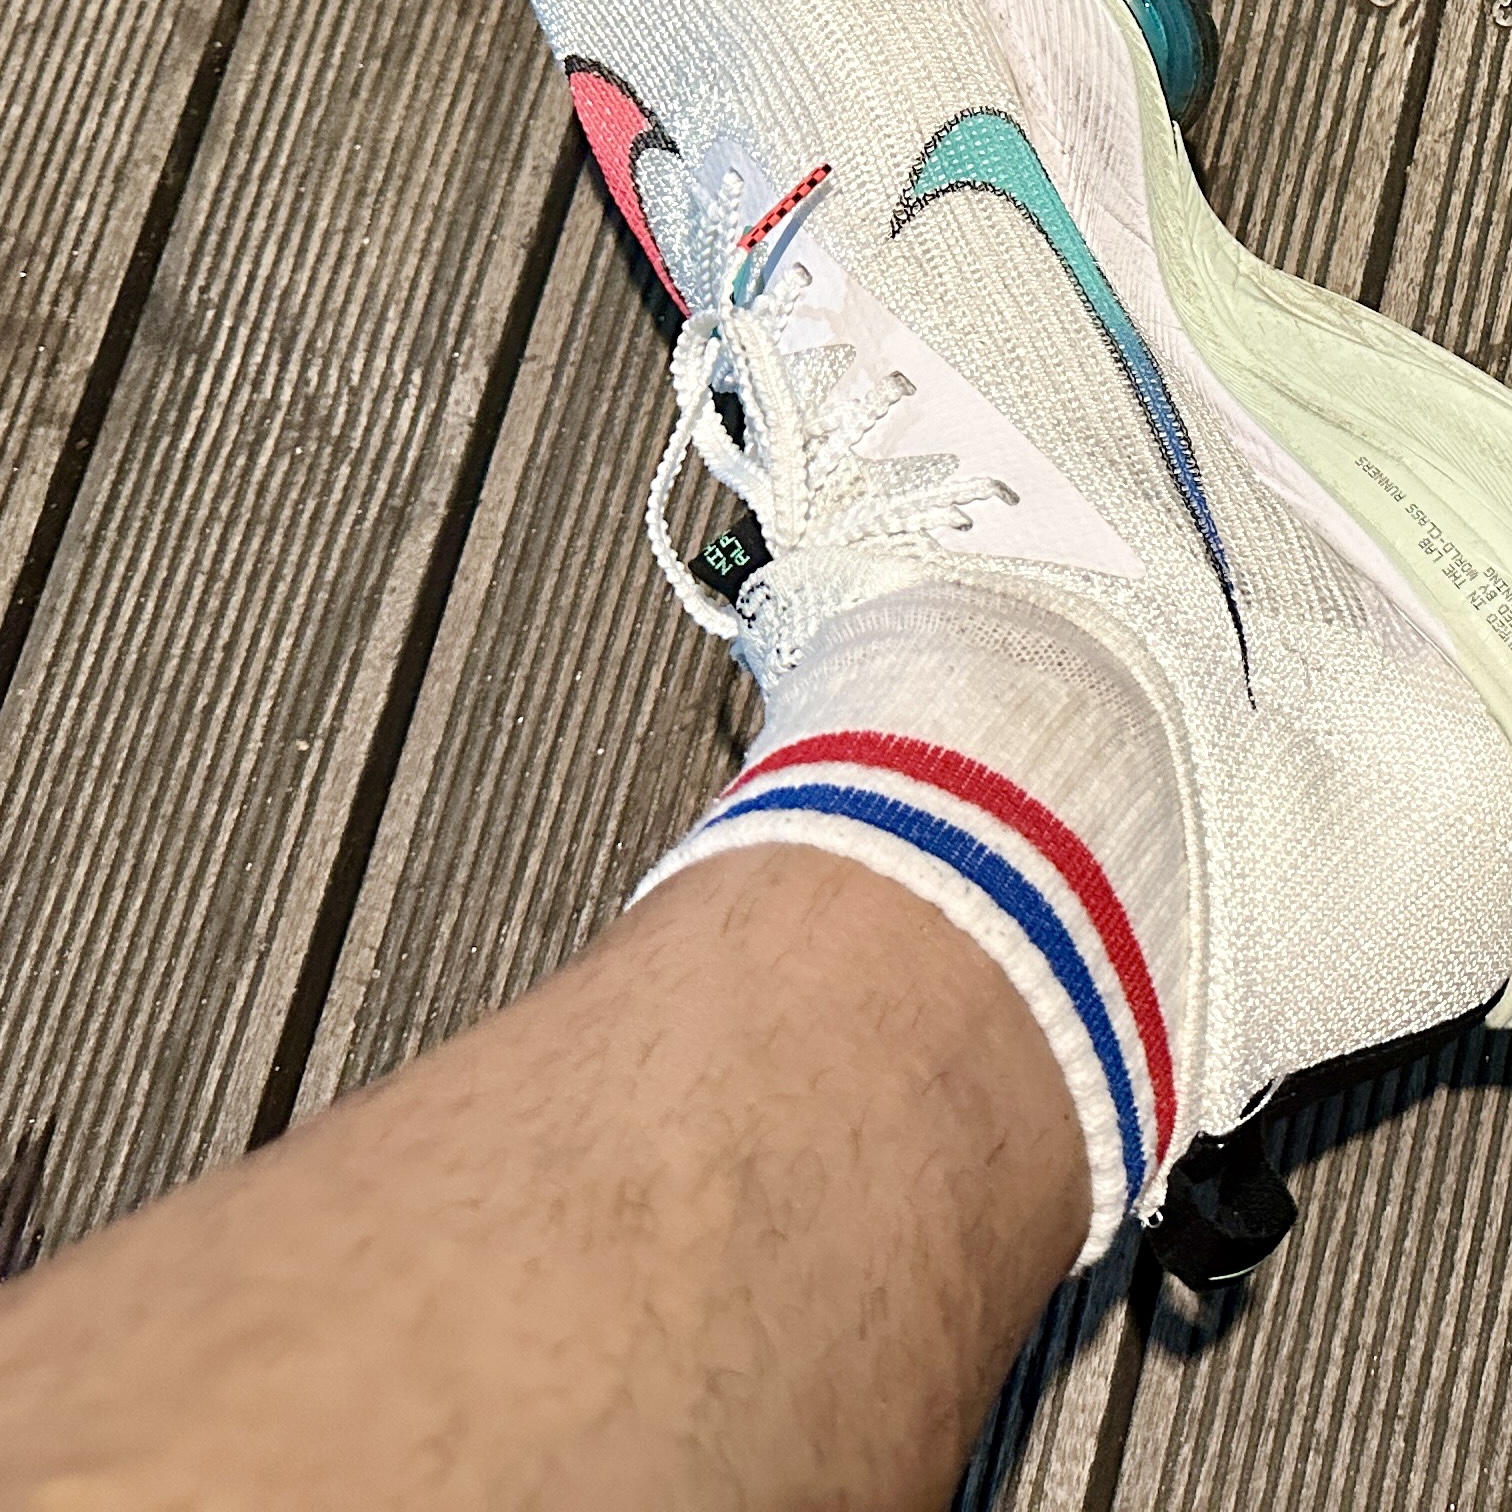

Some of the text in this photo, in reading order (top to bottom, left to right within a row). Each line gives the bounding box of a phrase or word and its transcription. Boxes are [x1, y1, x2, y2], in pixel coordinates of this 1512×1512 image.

[1354, 455, 1407, 503] RUNNERS
[1404, 502, 1479, 582] WORLD-CLASS
[1418, 537, 1445, 564] LAB
[1441, 563, 1468, 590] THE
[1466, 590, 1488, 611] IN
[1478, 584, 1498, 602] BY
